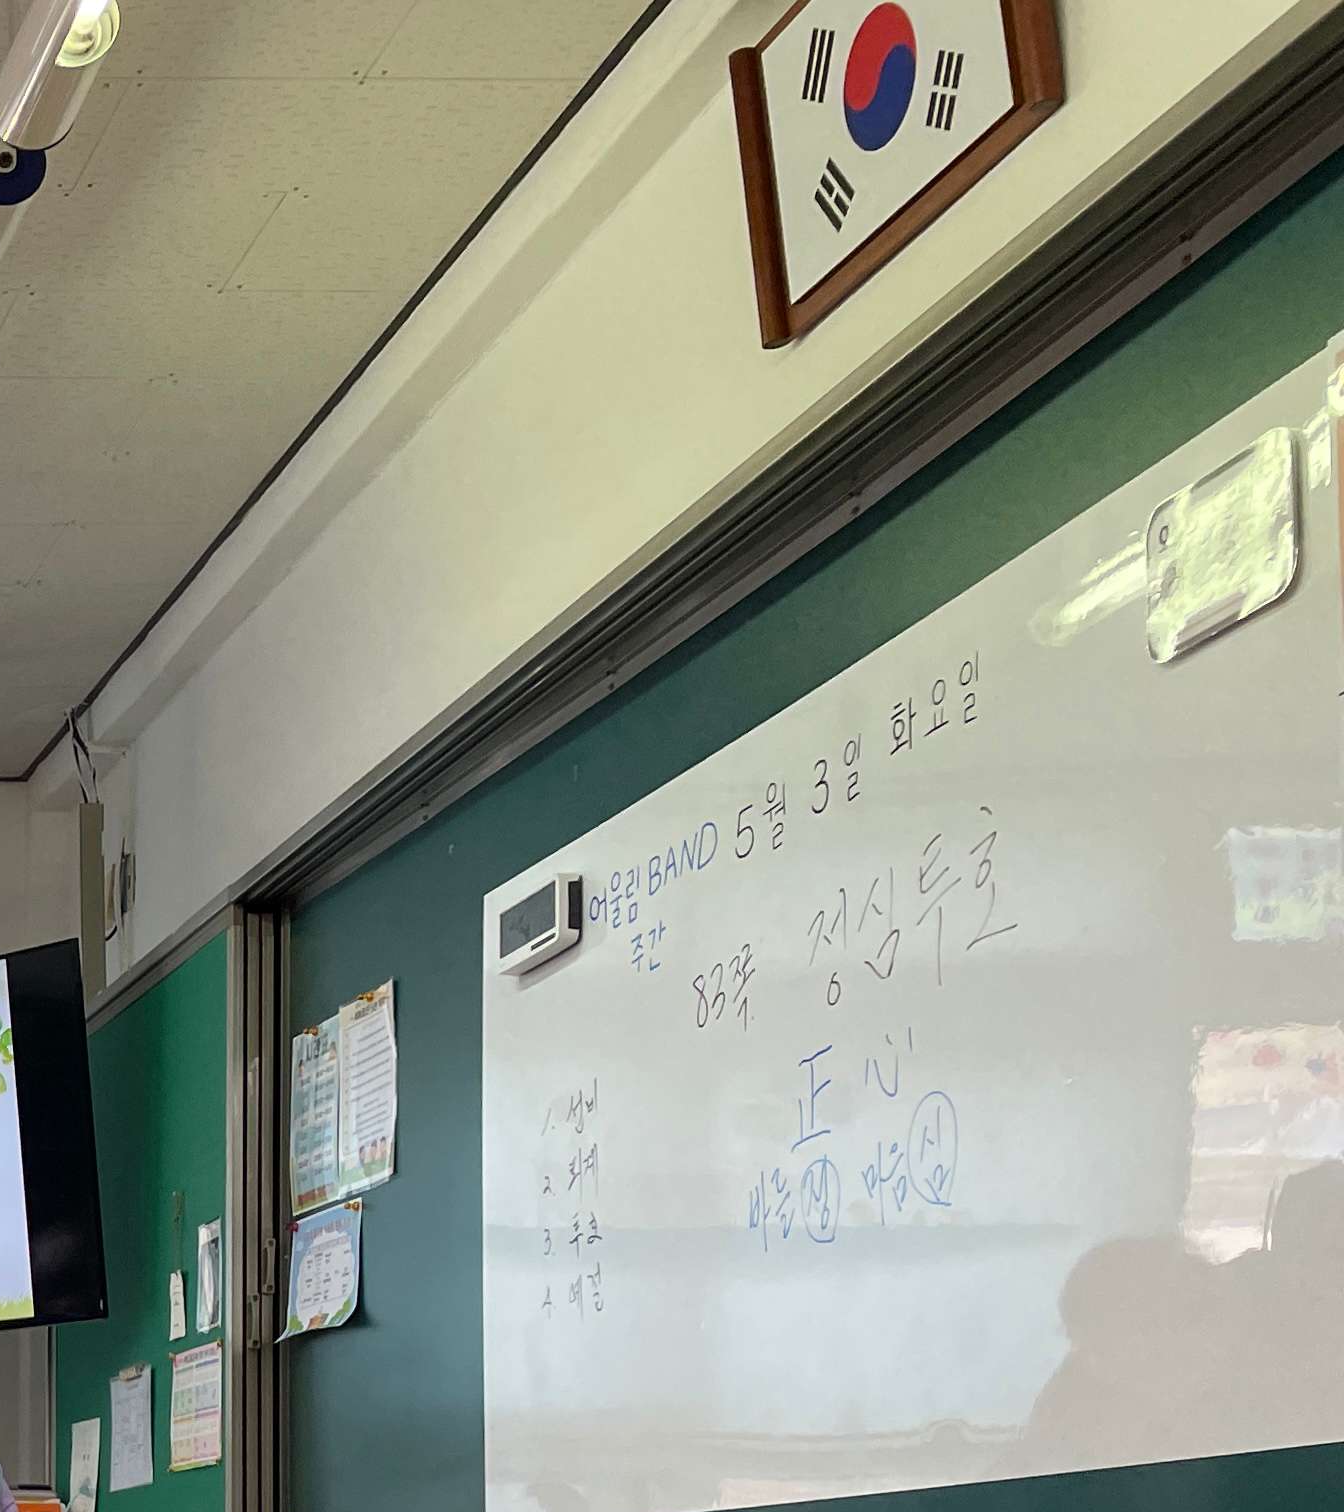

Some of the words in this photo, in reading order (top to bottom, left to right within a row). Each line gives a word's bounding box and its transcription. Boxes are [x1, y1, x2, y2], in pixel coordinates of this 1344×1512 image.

[647, 821, 718, 896] BAND
[734, 781, 787, 860] 5월
[811, 732, 862, 815] 3일
[889, 649, 980, 756] 화요일
